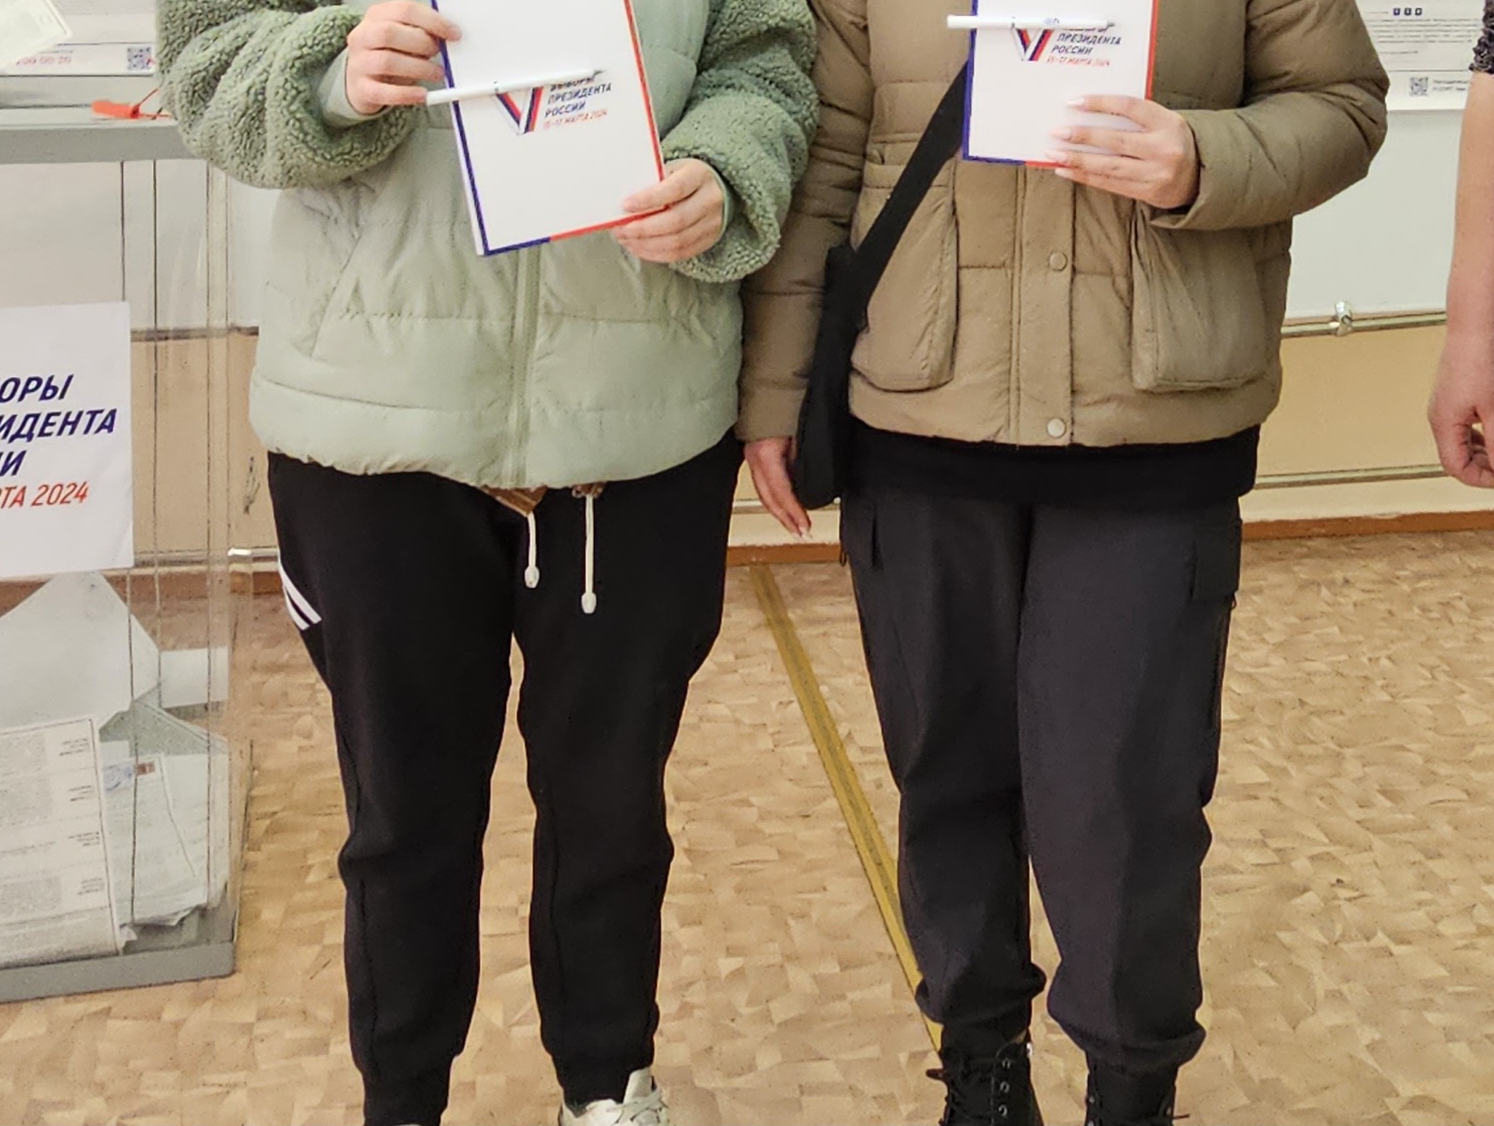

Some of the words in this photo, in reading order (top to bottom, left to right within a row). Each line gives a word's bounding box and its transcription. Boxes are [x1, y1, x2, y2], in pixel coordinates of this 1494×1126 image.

[1057, 32, 1121, 45] ПРЕЗИДЕНТА
[1051, 45, 1093, 55] РОССИИ
[547, 83, 612, 105] ПРЕЗИДЕНТА
[544, 101, 586, 118] РОССИИ
[31, 481, 88, 507] 2024
